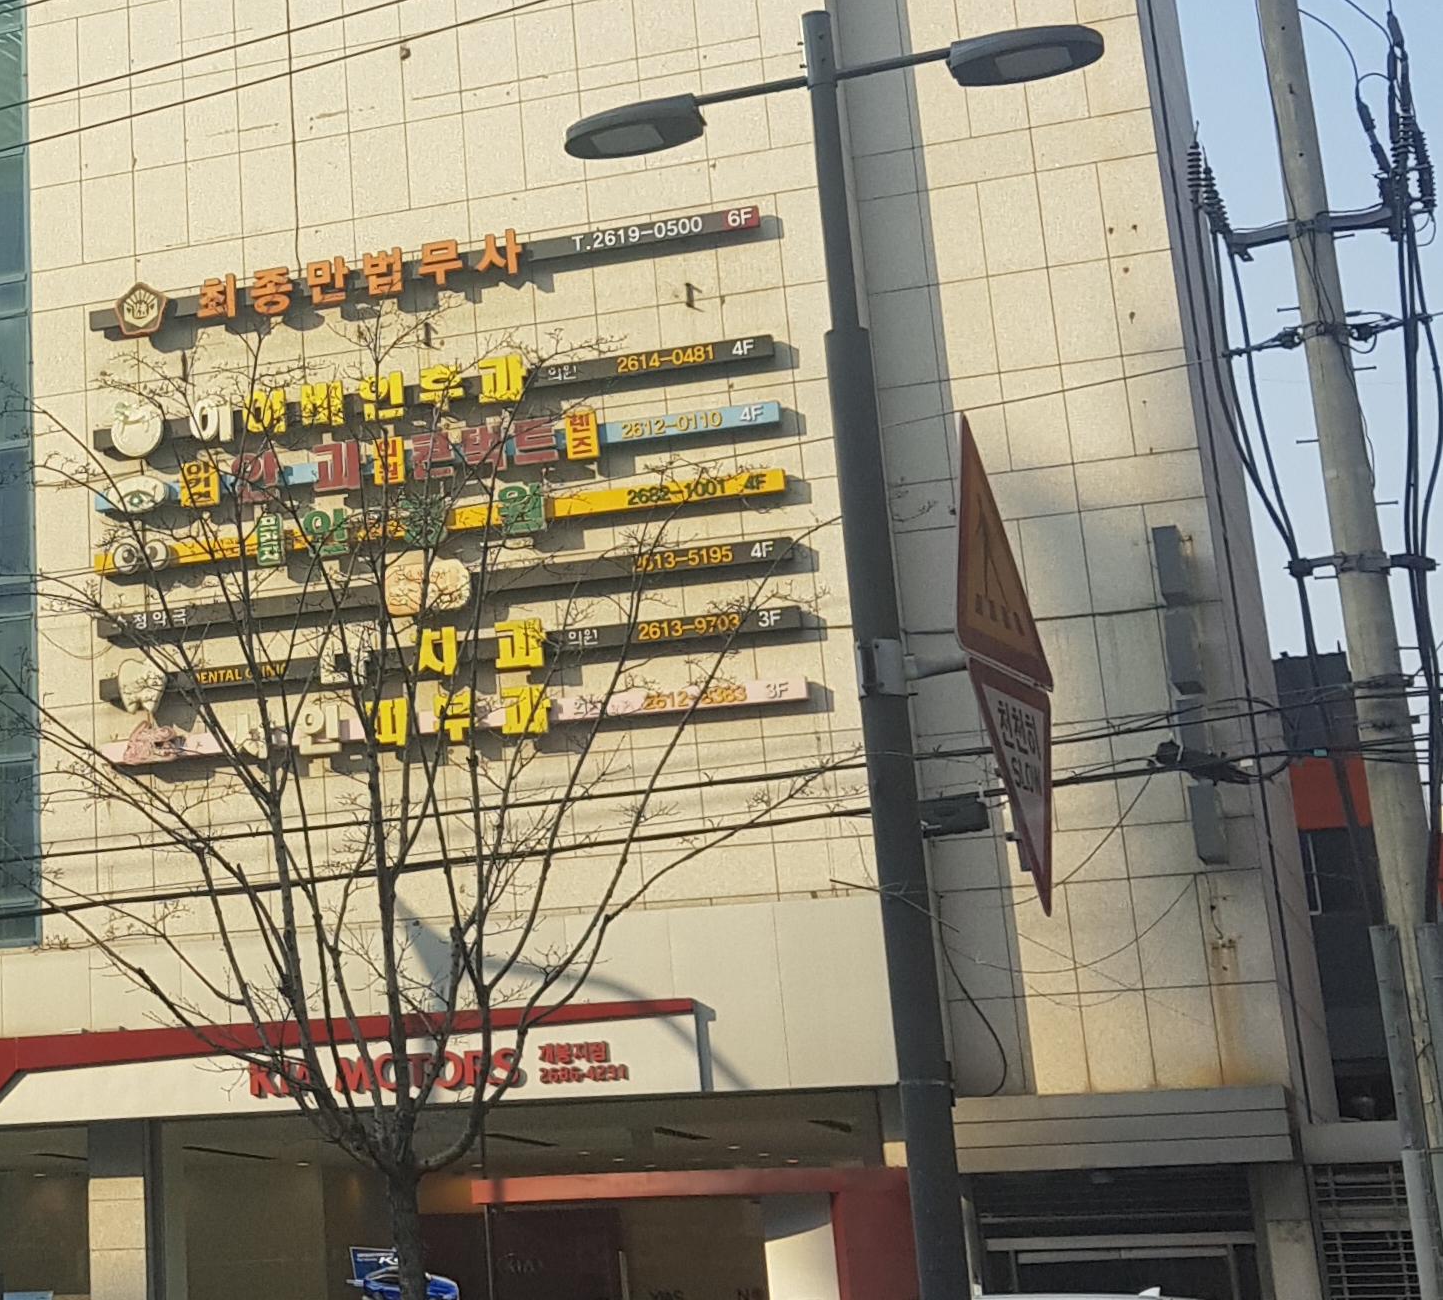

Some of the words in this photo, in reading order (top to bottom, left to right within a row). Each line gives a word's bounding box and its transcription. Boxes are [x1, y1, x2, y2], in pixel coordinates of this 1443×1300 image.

[572, 216, 703, 250] T.2619-0500
[727, 207, 753, 227] 6F
[547, 364, 577, 381] 의원
[617, 344, 714, 373] 2614-0481
[732, 339, 754, 356] 4F
[569, 413, 593, 456] 렌즈
[621, 411, 722, 439] 2612-0110
[740, 404, 764, 423] 4F
[744, 473, 767, 490] 4F
[635, 546, 733, 573] 2613-5195
[751, 541, 774, 558] 4F
[568, 629, 599, 646] 의원
[638, 612, 741, 641] 2613-9703
[758, 609, 782, 628] 3F
[765, 682, 790, 699] 3F
